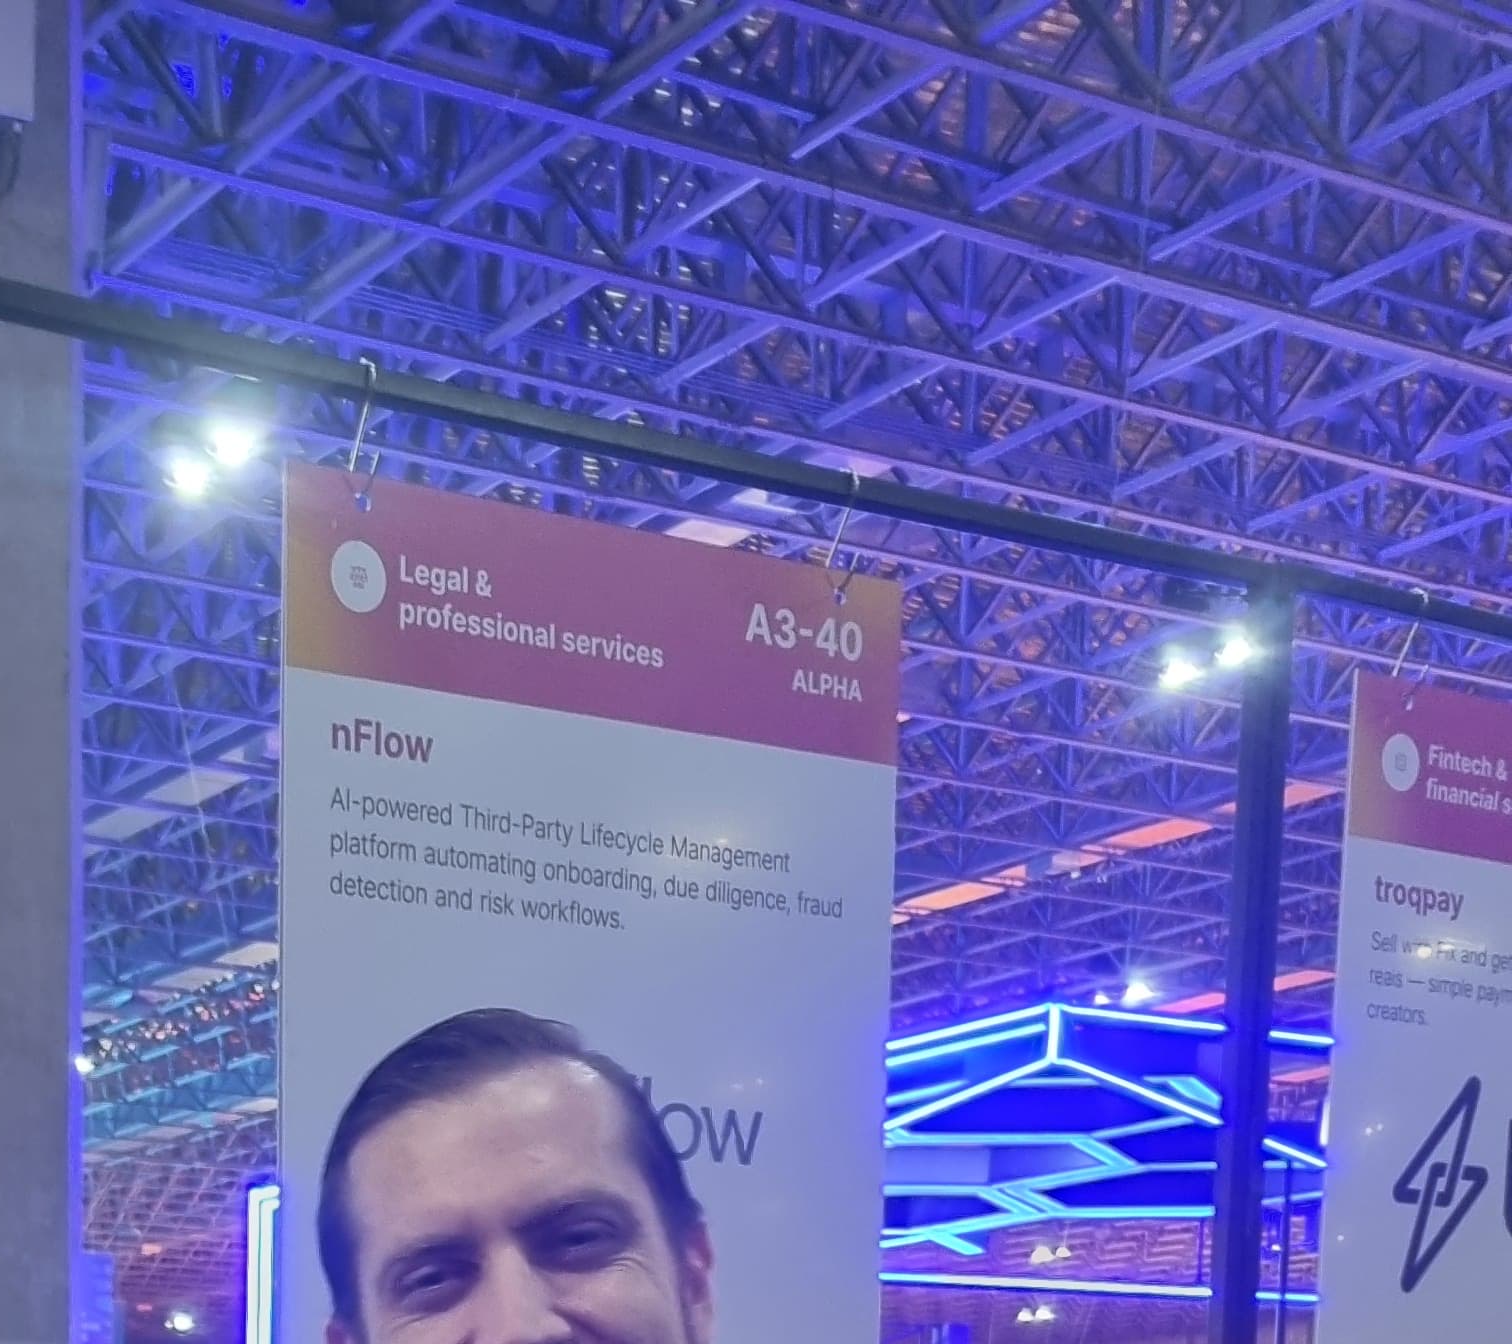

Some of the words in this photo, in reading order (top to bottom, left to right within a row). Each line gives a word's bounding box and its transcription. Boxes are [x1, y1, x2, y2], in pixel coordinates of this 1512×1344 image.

[399, 554, 469, 596] Legal
[475, 569, 492, 598] &
[399, 602, 556, 650] professional
[561, 632, 665, 668] services
[745, 602, 863, 662] A3-40
[791, 668, 863, 702] ALPHA
[331, 718, 434, 763] nFlow
[1428, 743, 1493, 778] Fintech
[1495, 759, 1508, 782] &
[1425, 777, 1500, 812] financial
[330, 786, 453, 828] AI-powered
[459, 803, 574, 848] Third-Party
[579, 821, 665, 857] Lifecycle
[670, 834, 792, 873] Management
[329, 830, 418, 863] platform
[423, 846, 537, 885] automating
[542, 860, 658, 901] onboarding,
[663, 875, 700, 900] due
[704, 880, 791, 917] diligence,
[796, 890, 844, 920] fraud
[1373, 874, 1465, 922] troqpay
[329, 872, 428, 906] detection
[434, 888, 473, 912] and
[479, 892, 516, 917] risk
[520, 898, 626, 931] workflows.
